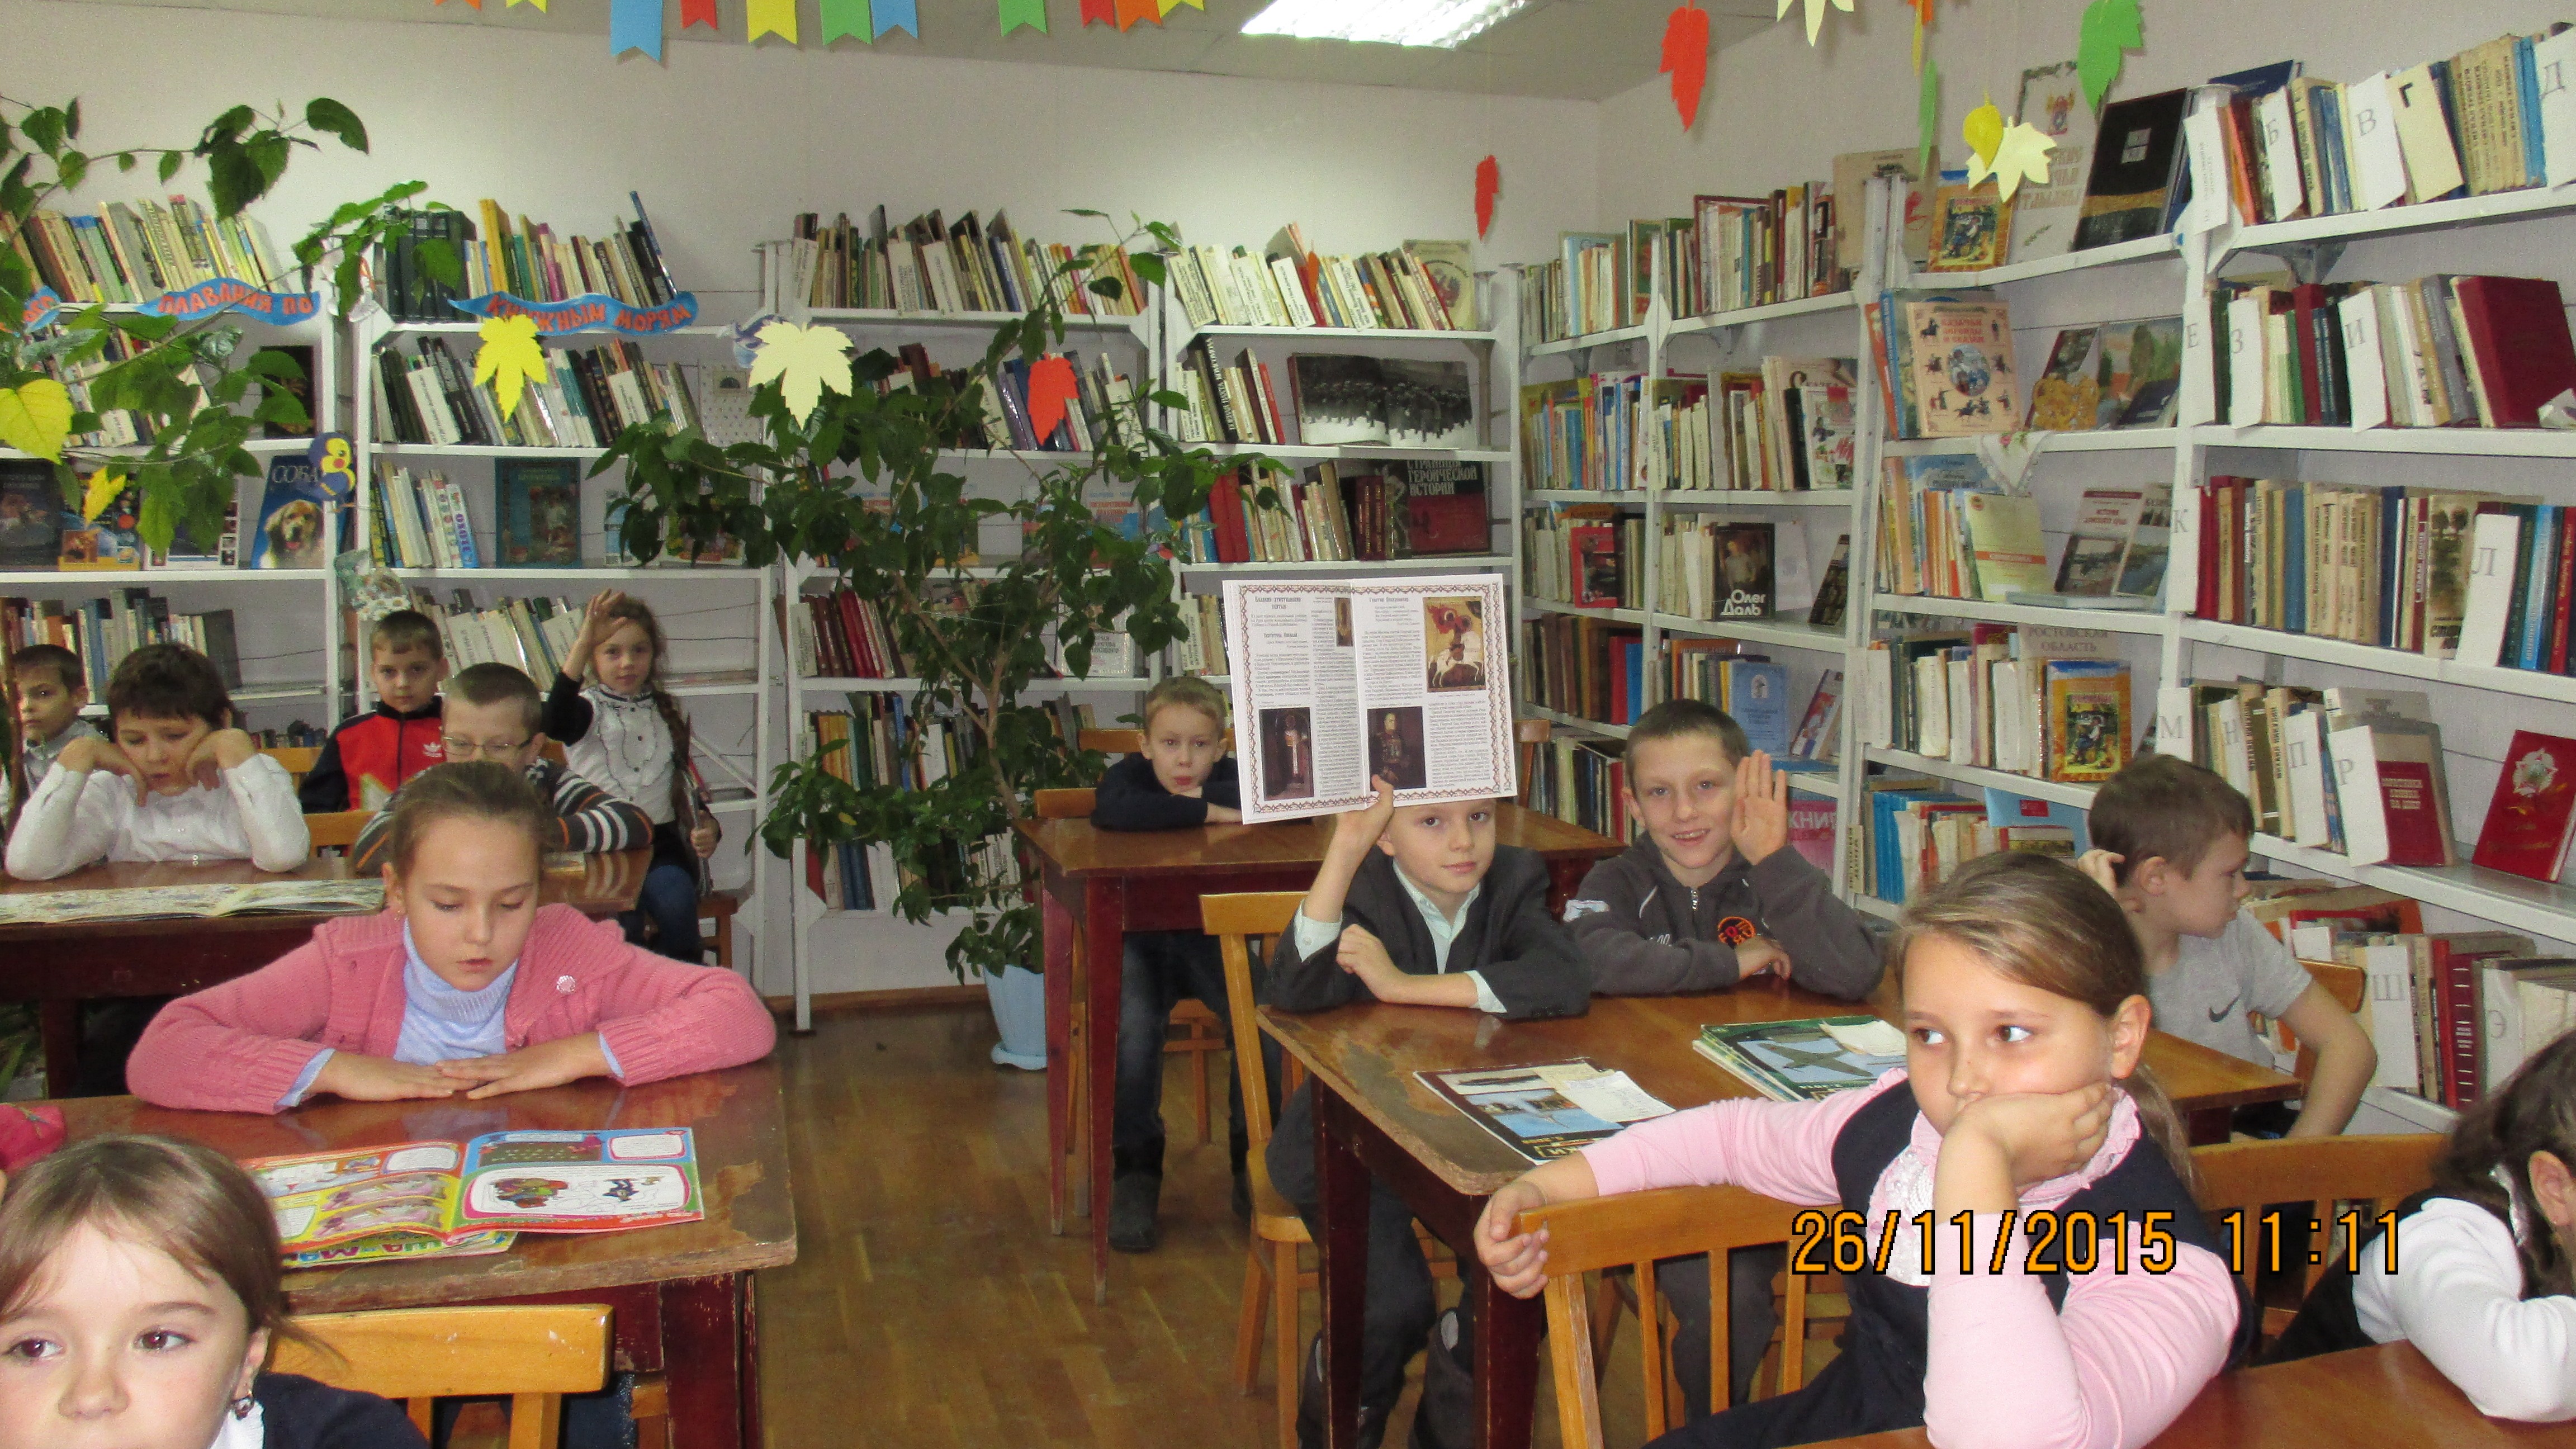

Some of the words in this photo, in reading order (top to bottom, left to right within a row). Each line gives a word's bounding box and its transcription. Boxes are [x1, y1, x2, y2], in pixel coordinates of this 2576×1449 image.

[2399, 82, 2413, 108] Г
[2265, 119, 2279, 146] Б
[2356, 108, 2377, 136] В
[157, 283, 273, 315] ПЛАВАНИЯ
[282, 297, 314, 315] ПО
[614, 304, 692, 332] МОРЯМ
[2185, 323, 2201, 349] Е
[2343, 317, 2366, 350] И
[1205, 338, 1223, 381] КОМСОМОЛА
[1408, 465, 1479, 483] ГЕРОИЧЕСКОЙ
[1409, 481, 1455, 496] ИСТОРИИ
[2172, 509, 2190, 533] К
[1720, 598, 1763, 616] Даль
[1731, 589, 1767, 604] Олег
[2040, 641, 2097, 652] ОБЛАСТЬ
[2158, 714, 2183, 739] М
[2222, 718, 2239, 746] Н
[2288, 741, 2308, 769] П
[2335, 758, 2354, 787] Р
[2370, 974, 2407, 1001] Ш
